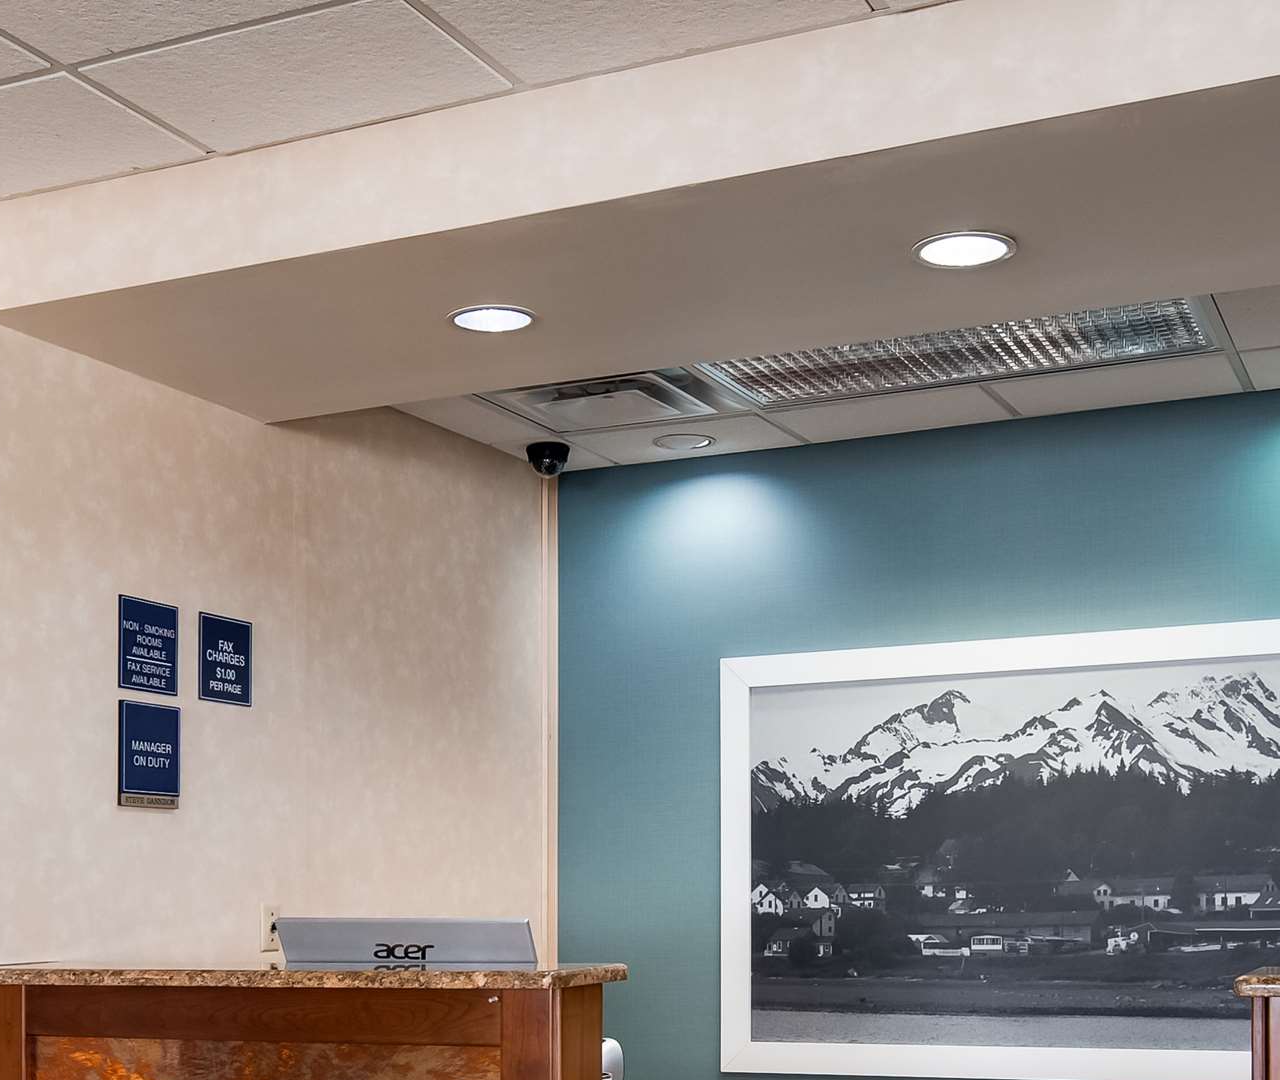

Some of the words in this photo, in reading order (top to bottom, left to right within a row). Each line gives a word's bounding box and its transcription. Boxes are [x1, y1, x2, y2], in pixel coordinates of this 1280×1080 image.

[123, 620, 138, 631] NON
[144, 626, 175, 639] SMOKING
[137, 636, 162, 648] ROOMS
[219, 640, 234, 652] FAX
[132, 646, 167, 660] AVAILABLE
[206, 650, 245, 667] CHARGES
[127, 661, 141, 672] FAX
[142, 664, 170, 677] SERVICE
[216, 667, 236, 681] $1.00
[131, 674, 166, 688] AVAILABLE
[210, 681, 223, 692] PER
[224, 683, 242, 694] PAGE
[132, 740, 172, 754] MANAGER
[134, 756, 146, 766] ON
[148, 757, 170, 768] DUTY
[373, 943, 434, 960] acer
